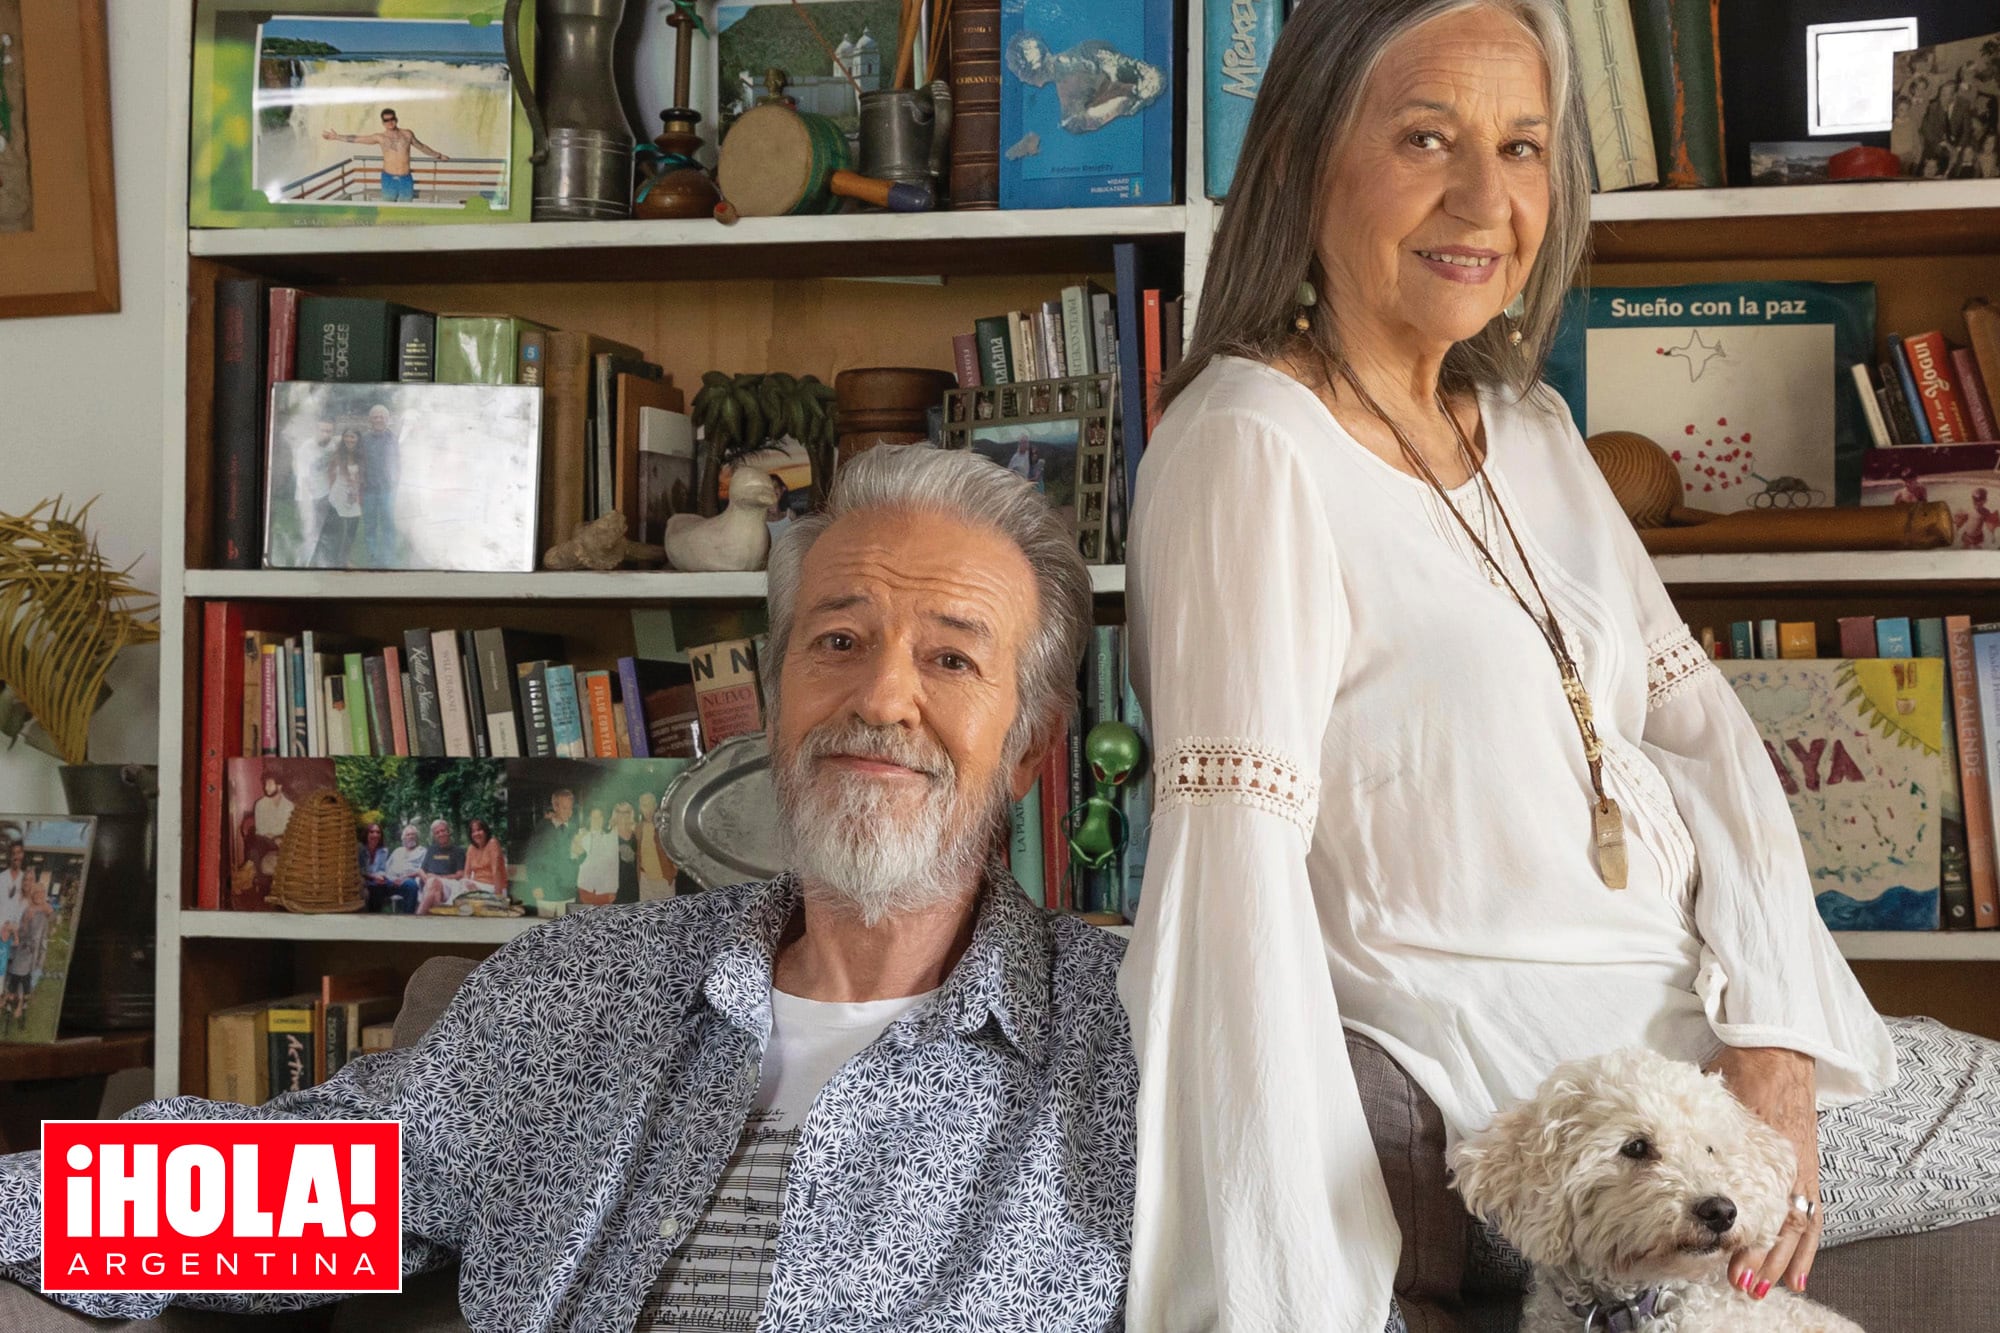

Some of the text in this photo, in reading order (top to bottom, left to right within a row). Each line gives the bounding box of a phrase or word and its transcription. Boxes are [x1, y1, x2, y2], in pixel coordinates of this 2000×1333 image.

[956, 75, 999, 85] CERVANTES
[1611, 296, 1807, 320] Sueño con la paz
[336, 323, 350, 379] BORGES
[526, 347, 535, 359] 5
[1914, 341, 1950, 398] YOGUI
[692, 653, 715, 682] N
[529, 680, 546, 728] RICHARD
[594, 685, 607, 713] JULIO
[1953, 627, 1981, 778] ISABEL ALLENDE
[1071, 735, 1081, 778] Argentina
[1016, 838, 1026, 853] LA
